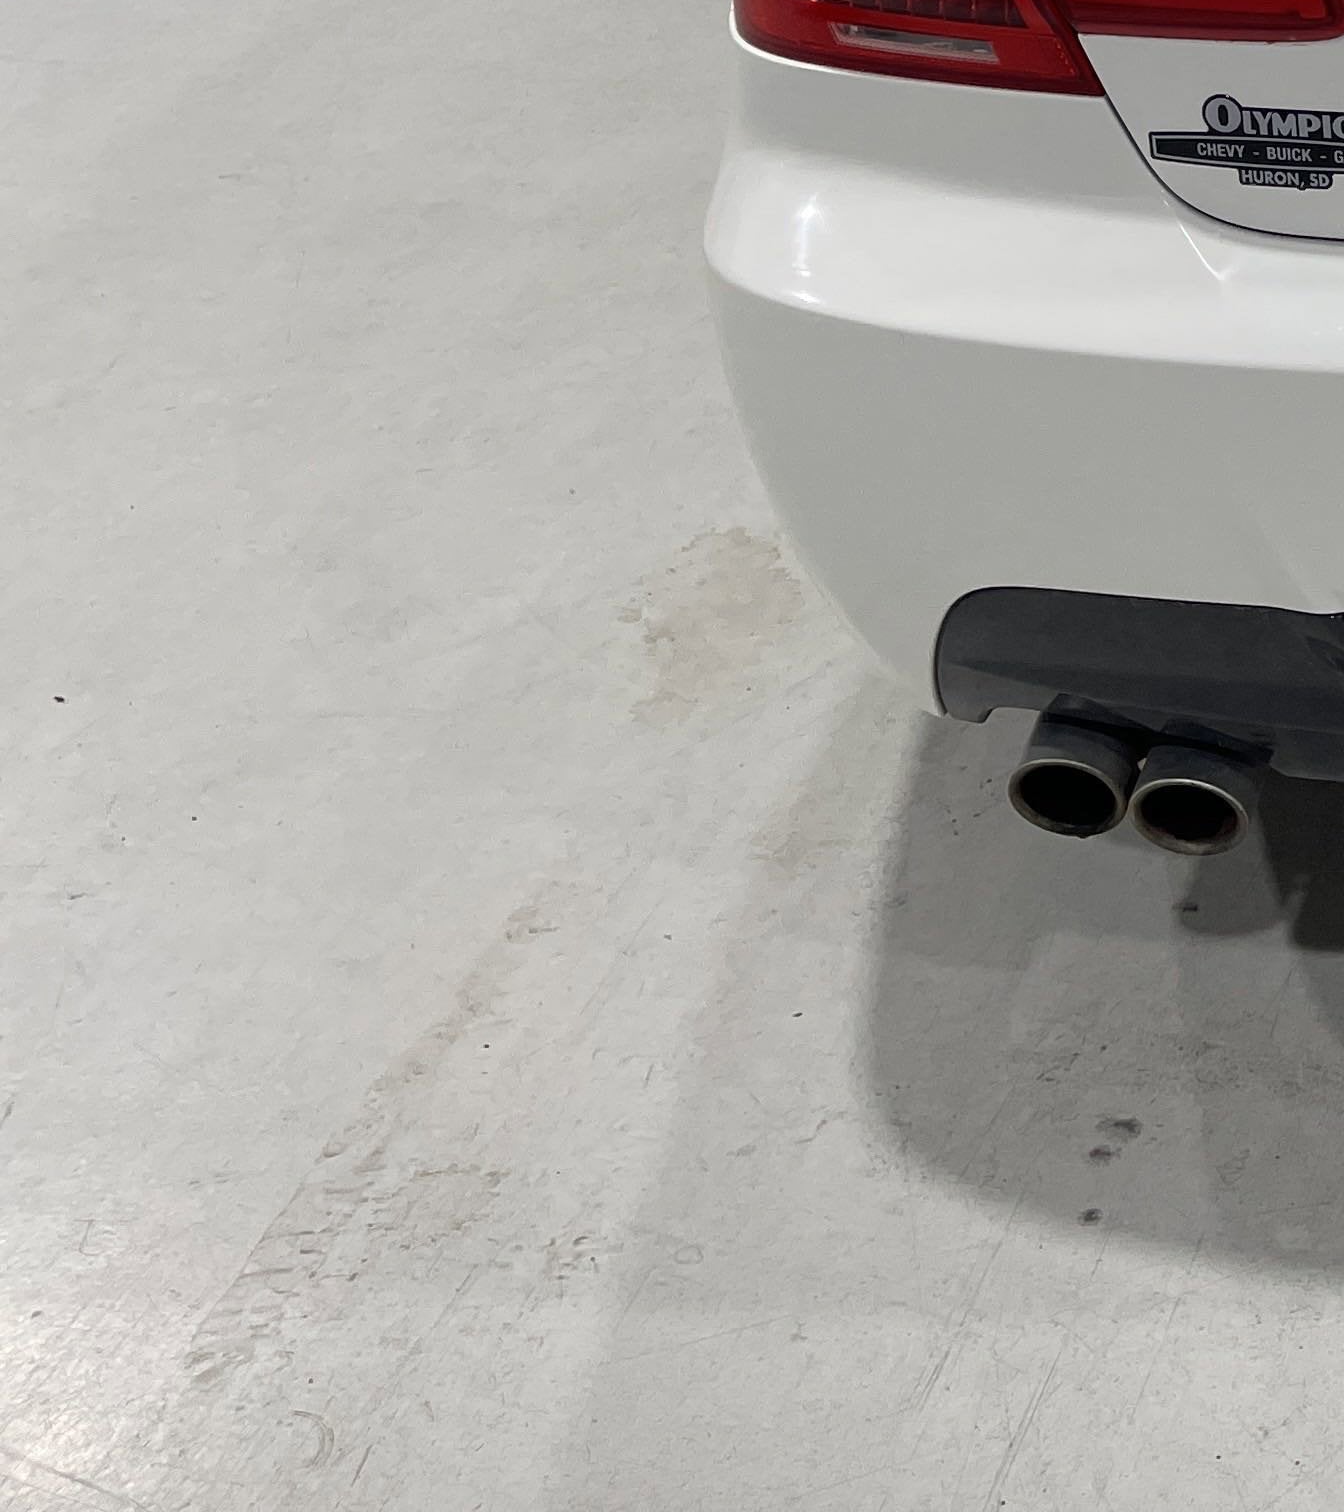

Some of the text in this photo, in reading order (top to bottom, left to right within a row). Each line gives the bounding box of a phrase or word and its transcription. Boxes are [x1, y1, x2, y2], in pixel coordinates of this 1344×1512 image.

[1196, 142, 1245, 159] CHEVY
[1266, 146, 1313, 163] BUICK
[1240, 169, 1331, 188] HURON, SD
